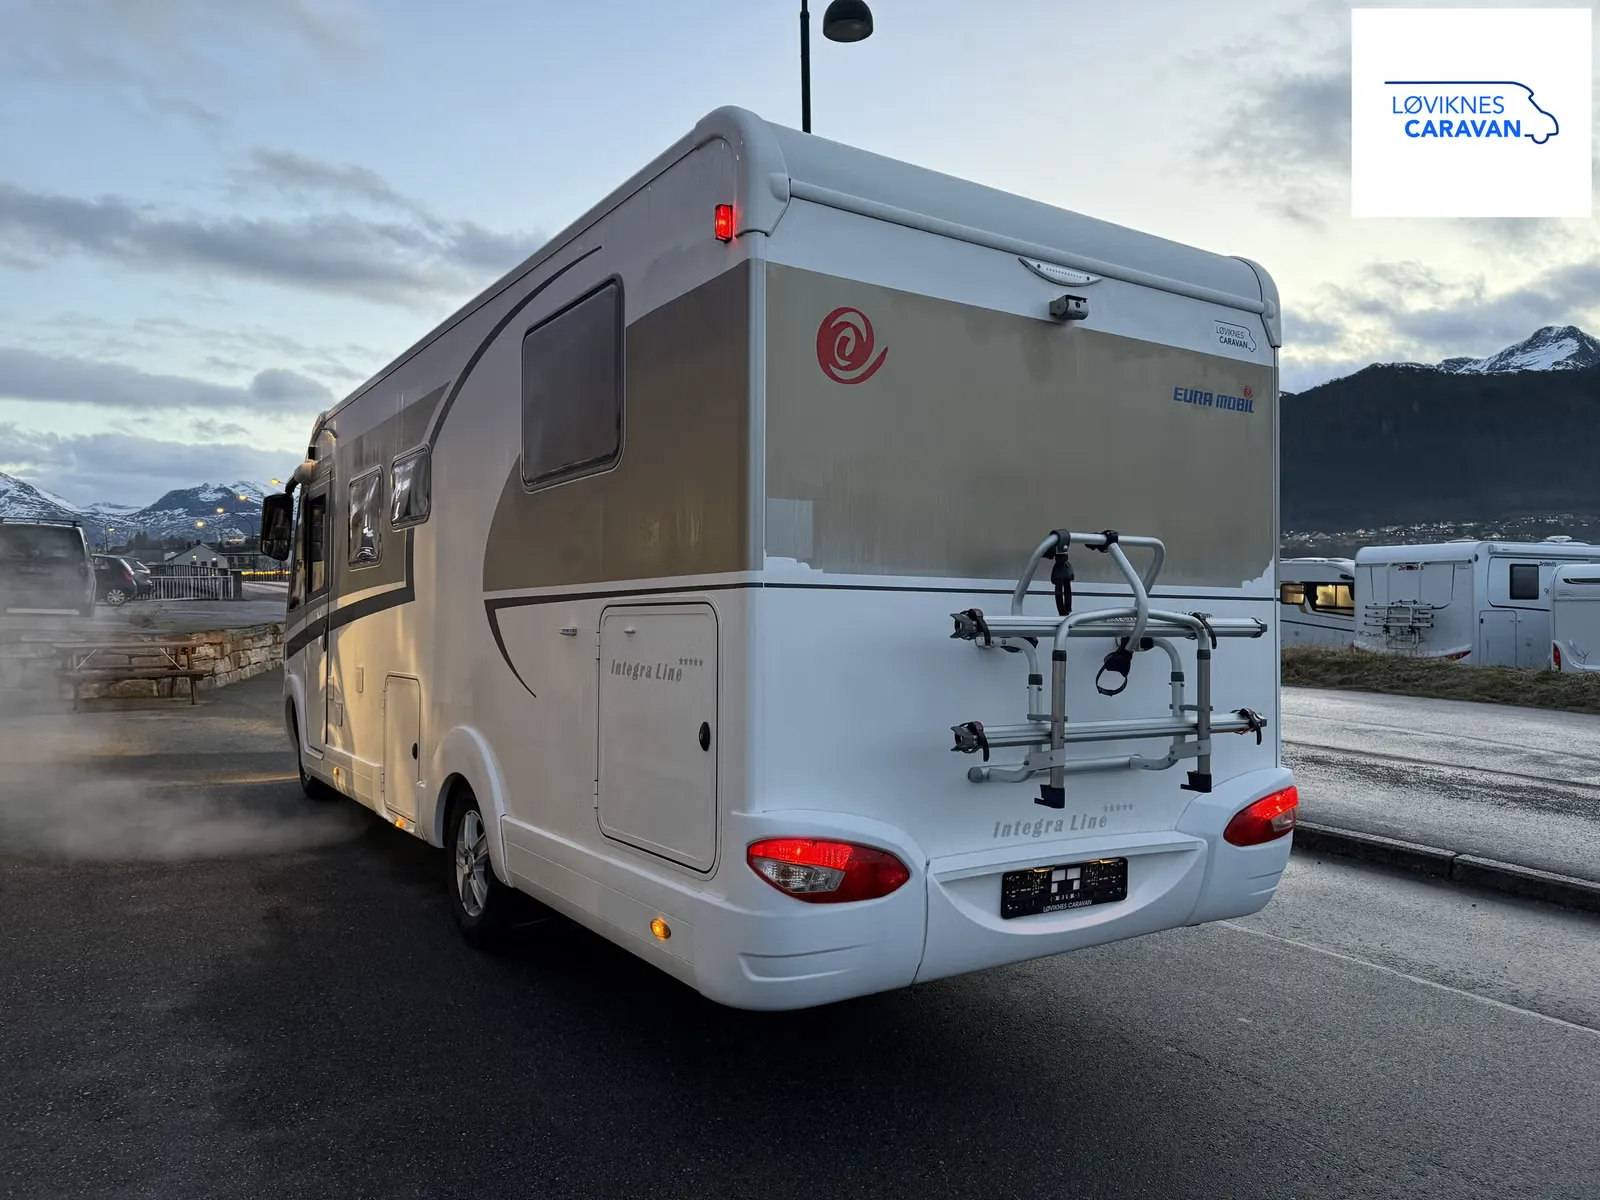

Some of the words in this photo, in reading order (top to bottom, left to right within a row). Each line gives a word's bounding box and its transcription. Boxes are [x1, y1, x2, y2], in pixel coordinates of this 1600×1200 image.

[1216, 326, 1245, 339] LØVIKNES
[1219, 336, 1248, 349] CARAVAN
[1173, 387, 1213, 406] EURA
[1216, 394, 1254, 413] MOBIL
[611, 659, 652, 681] Integra
[656, 663, 682, 682] Line
[993, 818, 1064, 839] Integra
[1070, 813, 1107, 831] Line
[1043, 902, 1067, 912] LØVIKNES
[1067, 899, 1092, 908] CARAVAN
